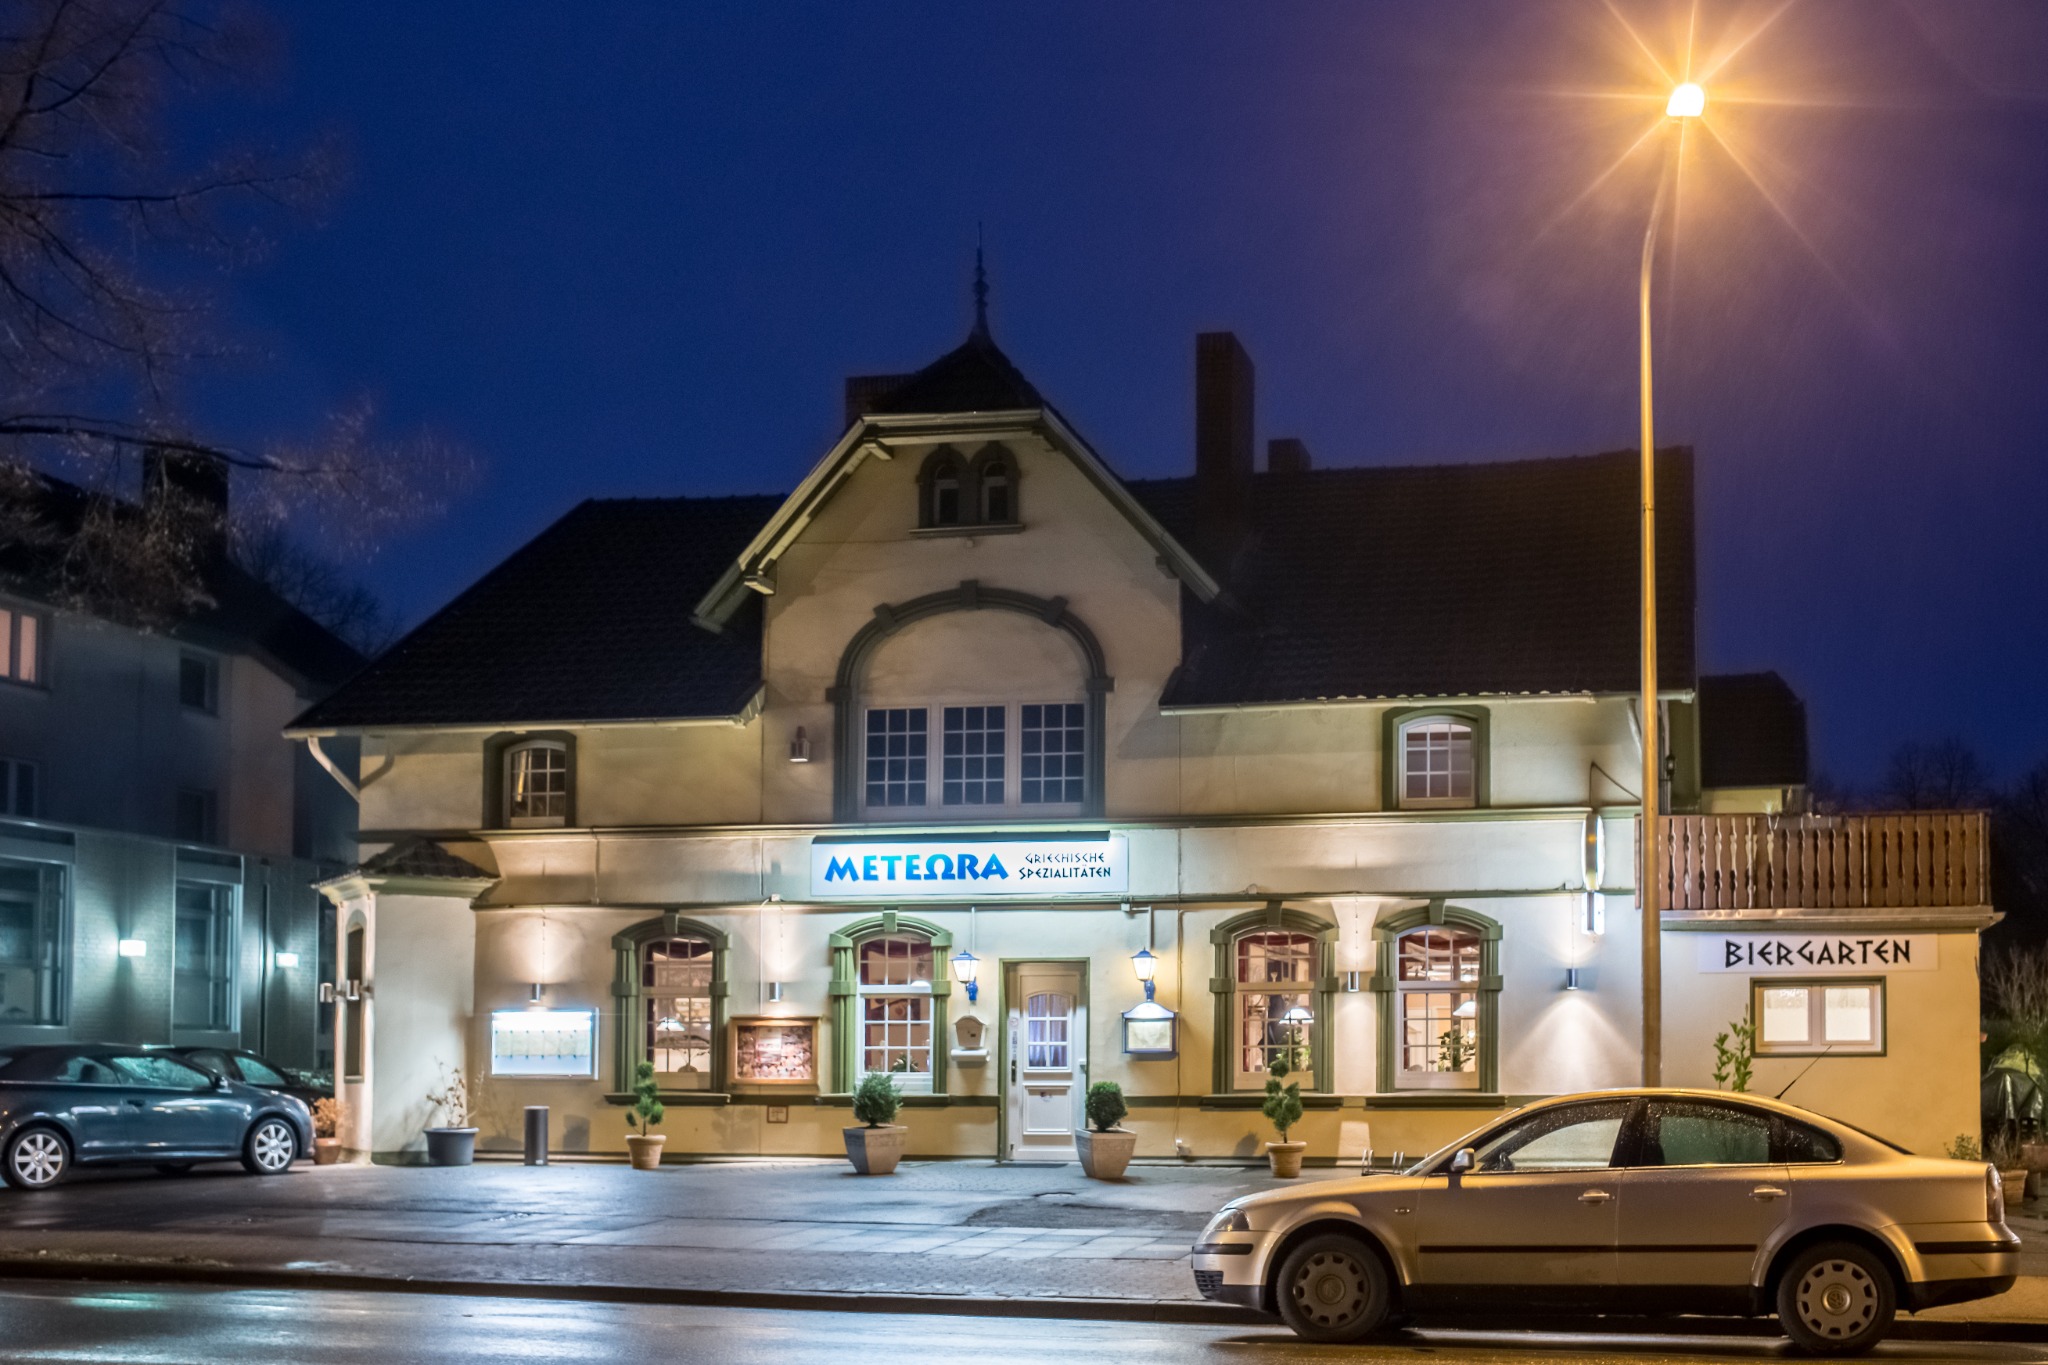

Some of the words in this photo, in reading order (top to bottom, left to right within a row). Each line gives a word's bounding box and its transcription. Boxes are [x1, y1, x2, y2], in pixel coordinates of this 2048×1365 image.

[1025, 853, 1105, 864] GRIECHISCHE
[1018, 864, 1111, 880] SPEZIALITÄTEN
[1725, 939, 1911, 968] BIERGARTEN
